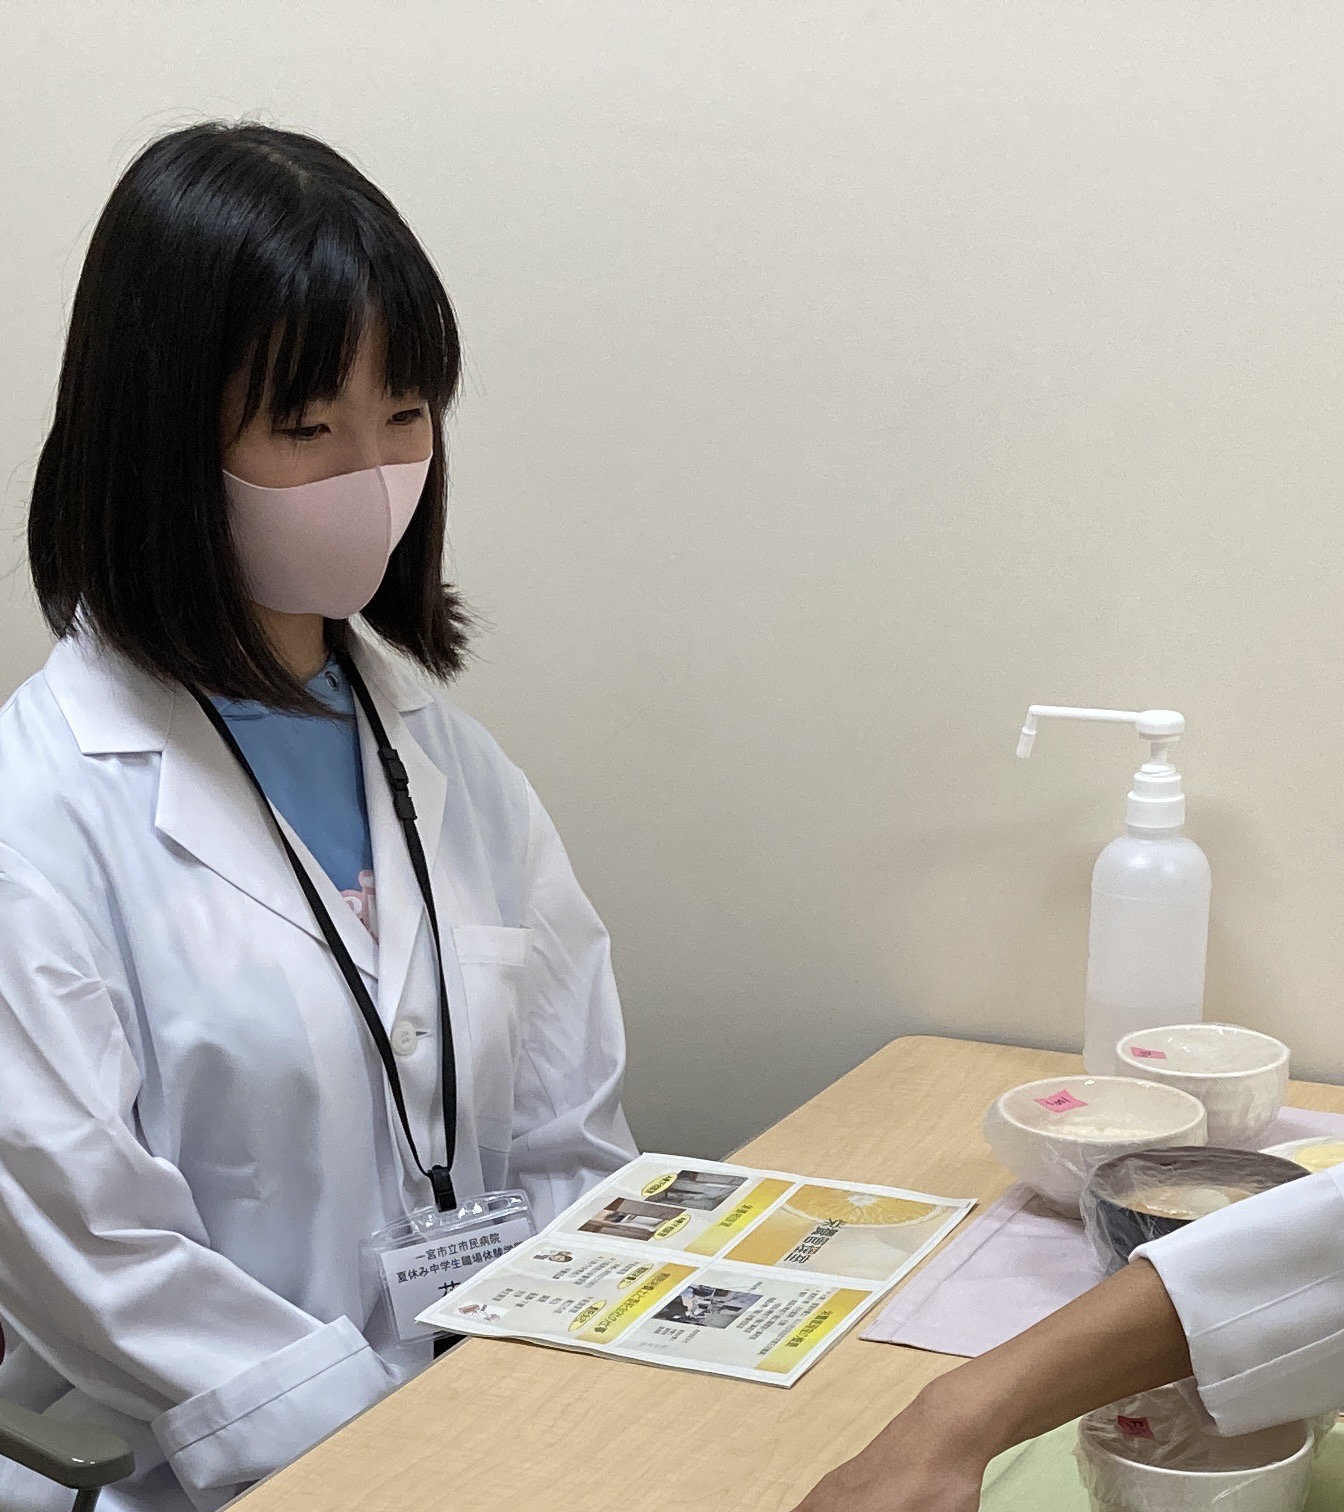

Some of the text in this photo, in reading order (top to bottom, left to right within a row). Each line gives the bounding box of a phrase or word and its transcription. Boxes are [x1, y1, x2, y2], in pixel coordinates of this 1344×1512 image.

[414, 1232, 502, 1262] 一宮市立市民病院
[781, 1217, 849, 1264] 栄養管理室
